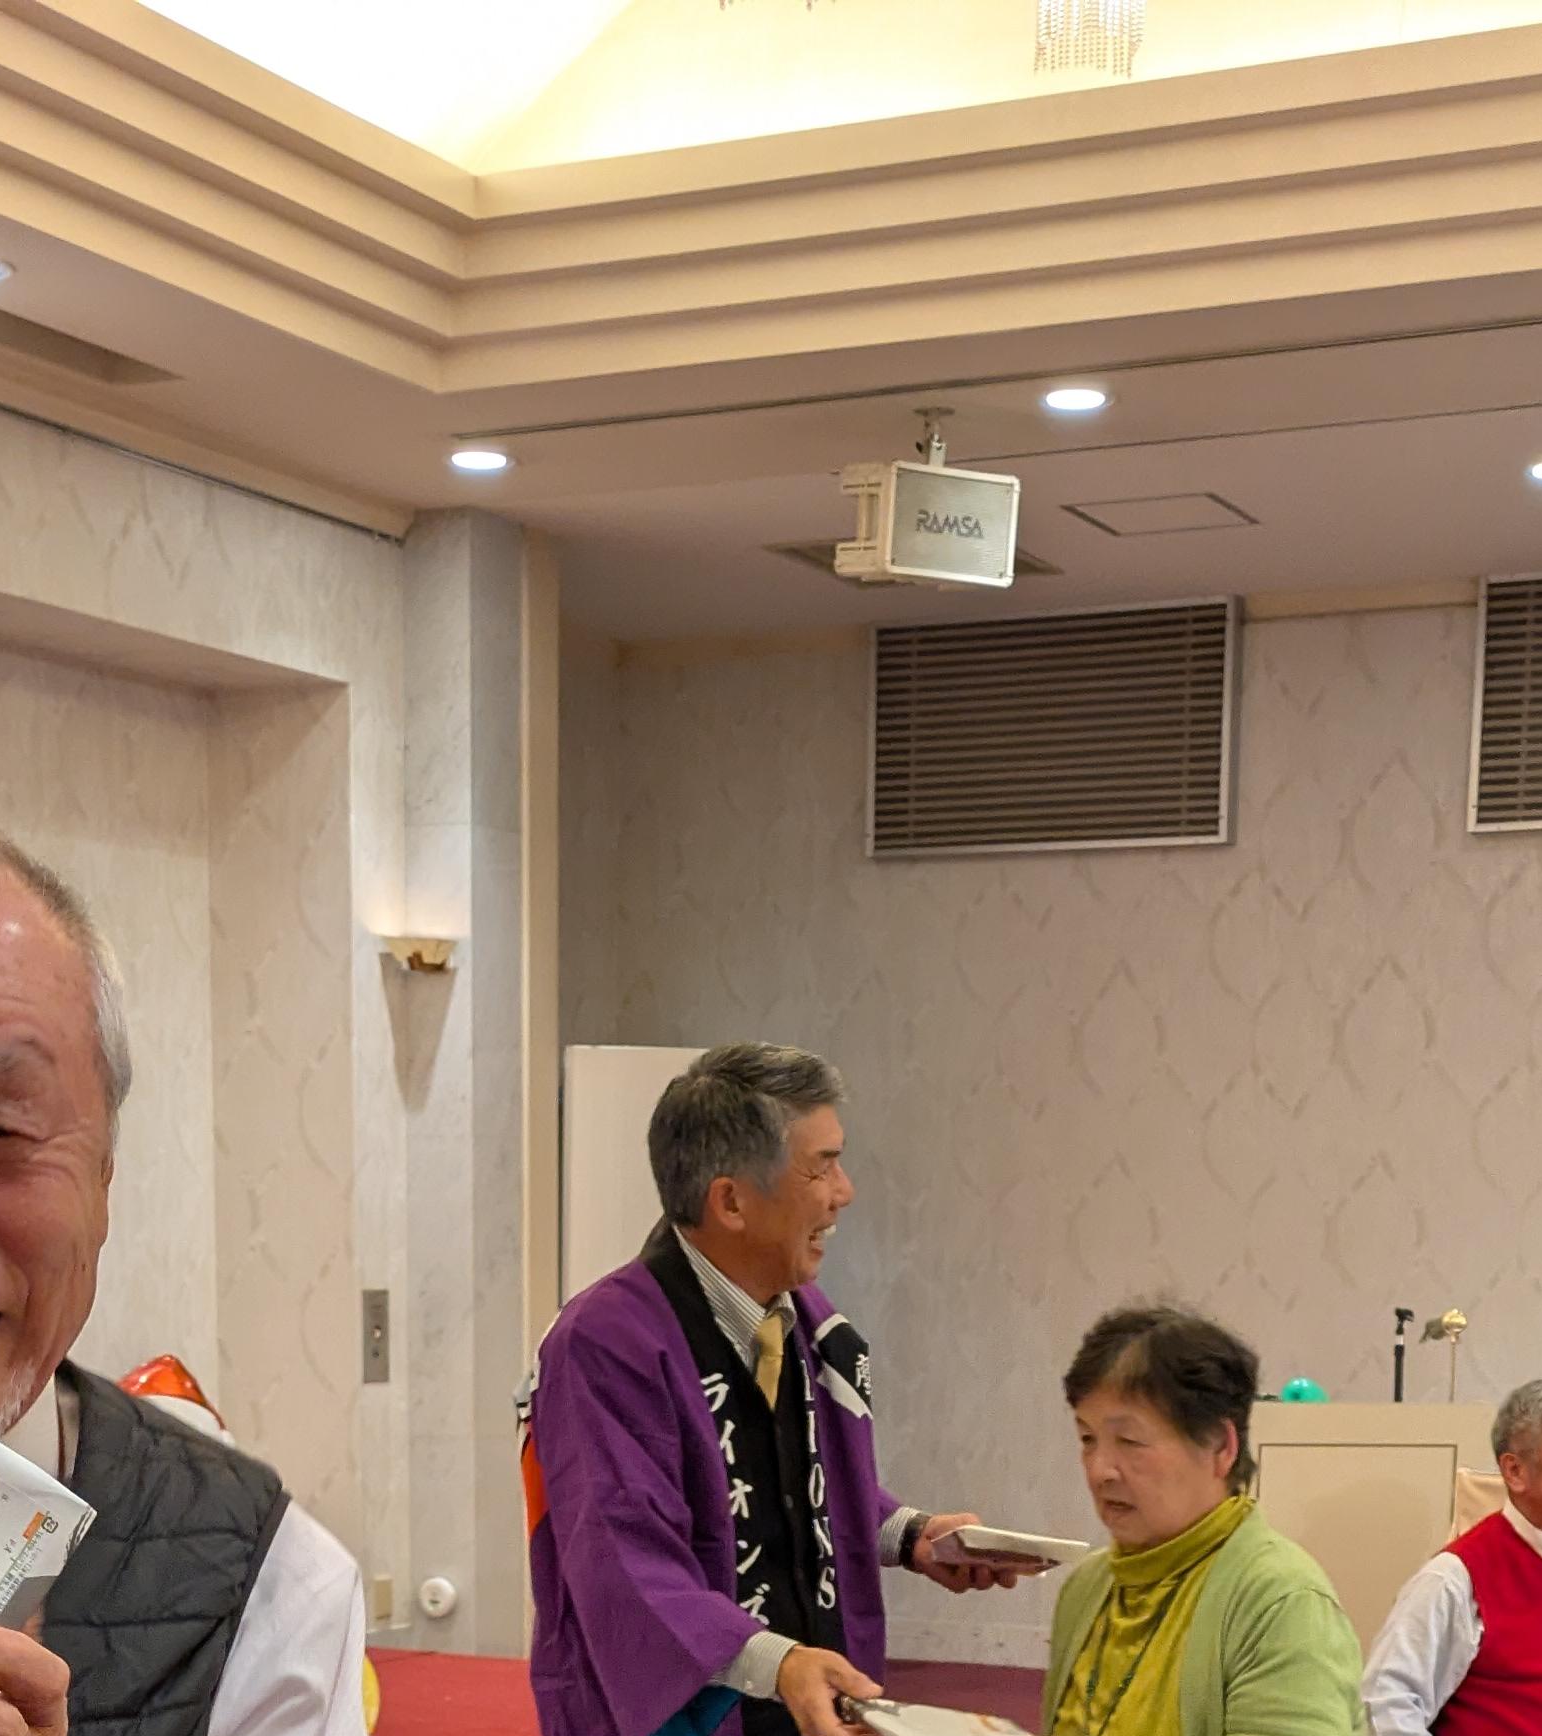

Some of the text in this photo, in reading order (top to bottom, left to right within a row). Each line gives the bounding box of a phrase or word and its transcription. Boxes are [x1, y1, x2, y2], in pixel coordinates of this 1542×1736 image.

[915, 509, 985, 539] RAMSA
[700, 1372, 771, 1626] ライオンズ
